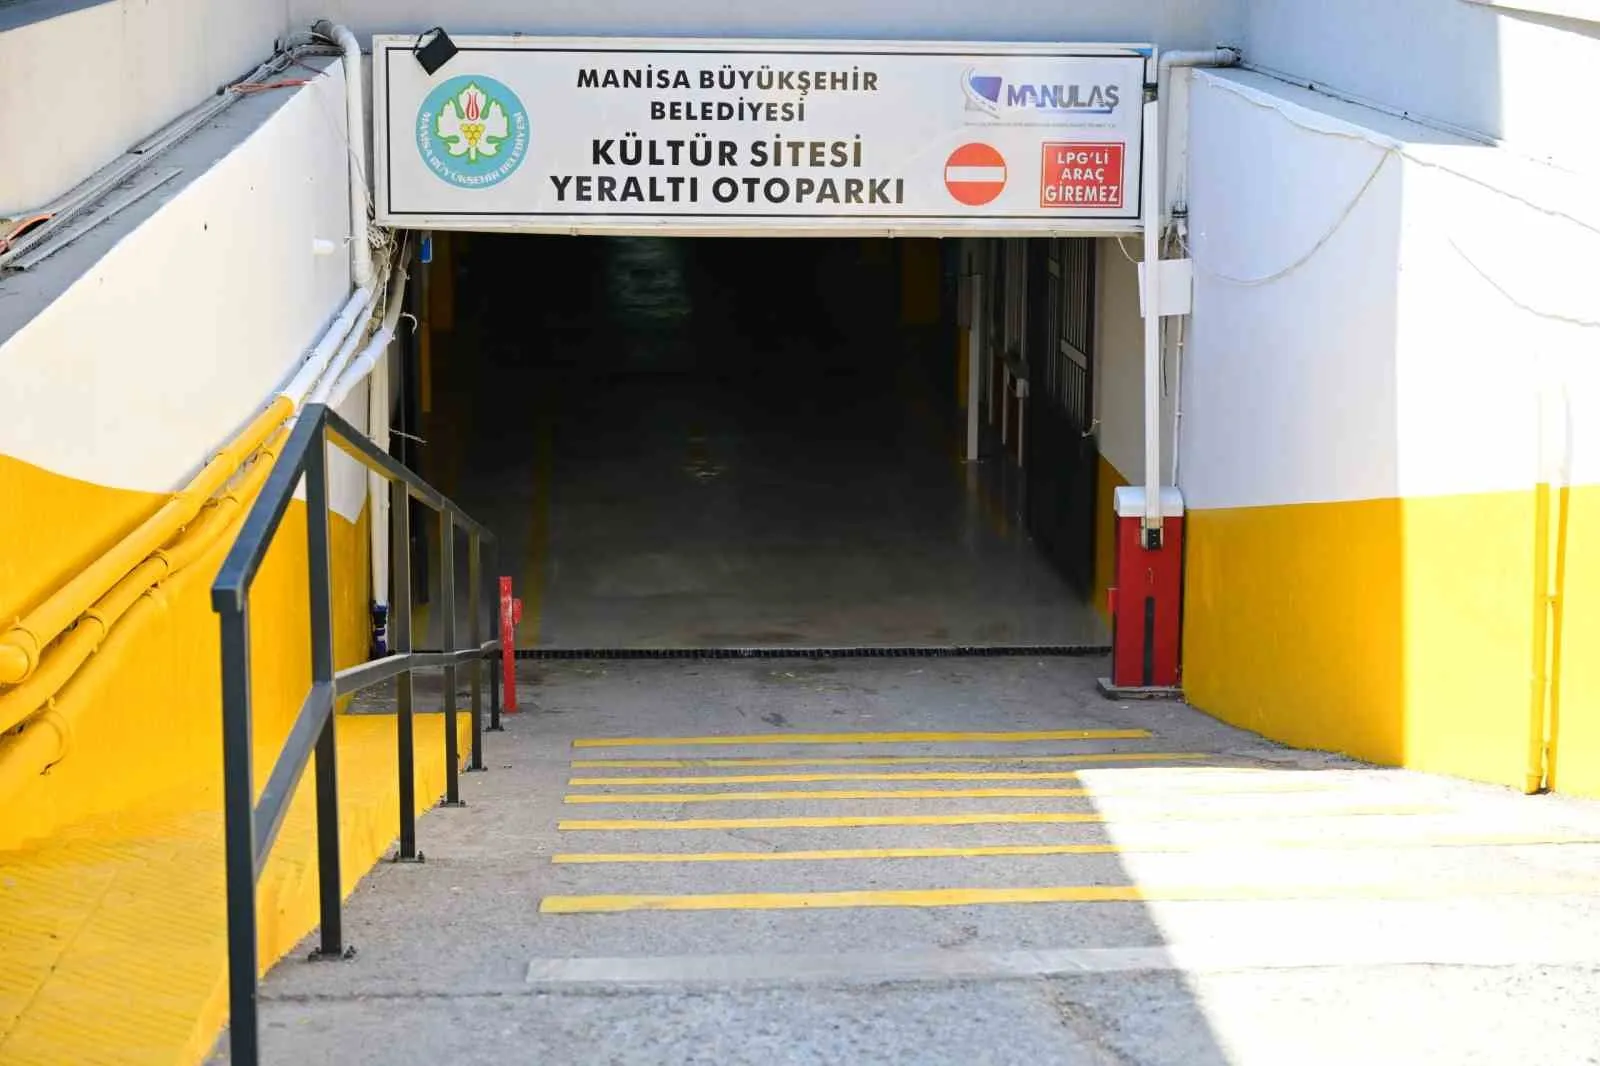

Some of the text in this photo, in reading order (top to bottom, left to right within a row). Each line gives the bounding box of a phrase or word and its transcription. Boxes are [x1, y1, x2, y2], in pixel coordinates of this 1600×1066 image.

[577, 64, 878, 95] MANİSA BÜYÜKŞEHİR
[650, 97, 804, 121] BELEDİYESİ
[1007, 84, 1120, 110] MANULAŞ
[592, 132, 862, 167] KÜLTÜR SİTESİ
[1057, 149, 1109, 165] LPG'Lİ
[1061, 168, 1105, 183] ARAÇ
[549, 175, 904, 204] YERALTI OTOPARKI
[1046, 184, 1118, 202] GİREMEZ
